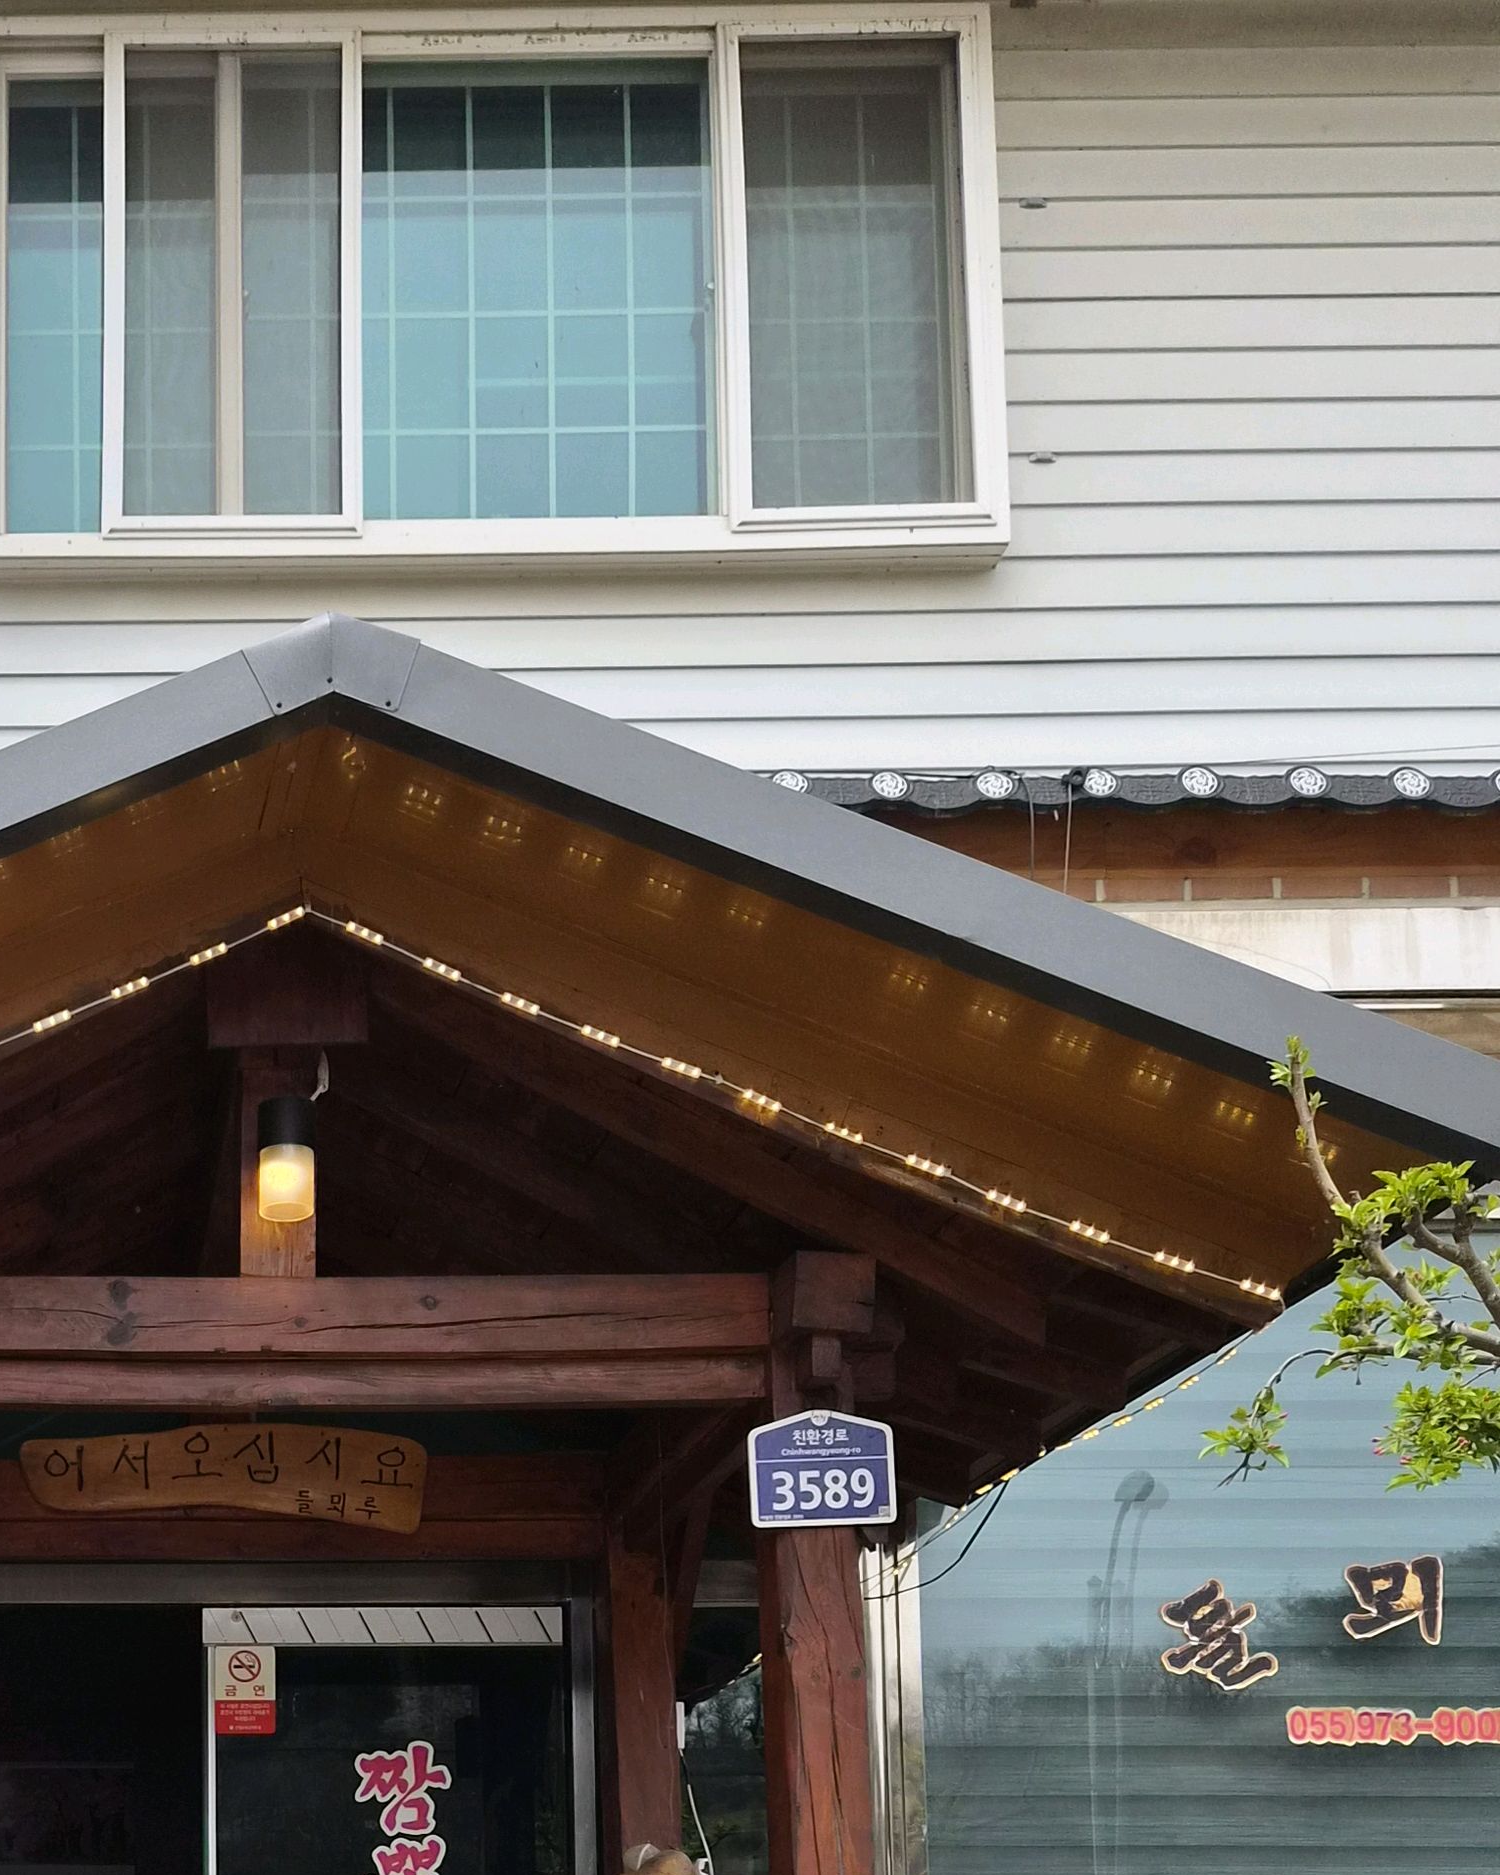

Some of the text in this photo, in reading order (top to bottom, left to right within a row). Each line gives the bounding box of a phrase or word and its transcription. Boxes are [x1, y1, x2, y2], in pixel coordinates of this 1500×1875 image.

[792, 1428, 849, 1446] 친환경로
[771, 1468, 876, 1511] 3589
[1286, 1706, 1500, 1746] 055)973-900
